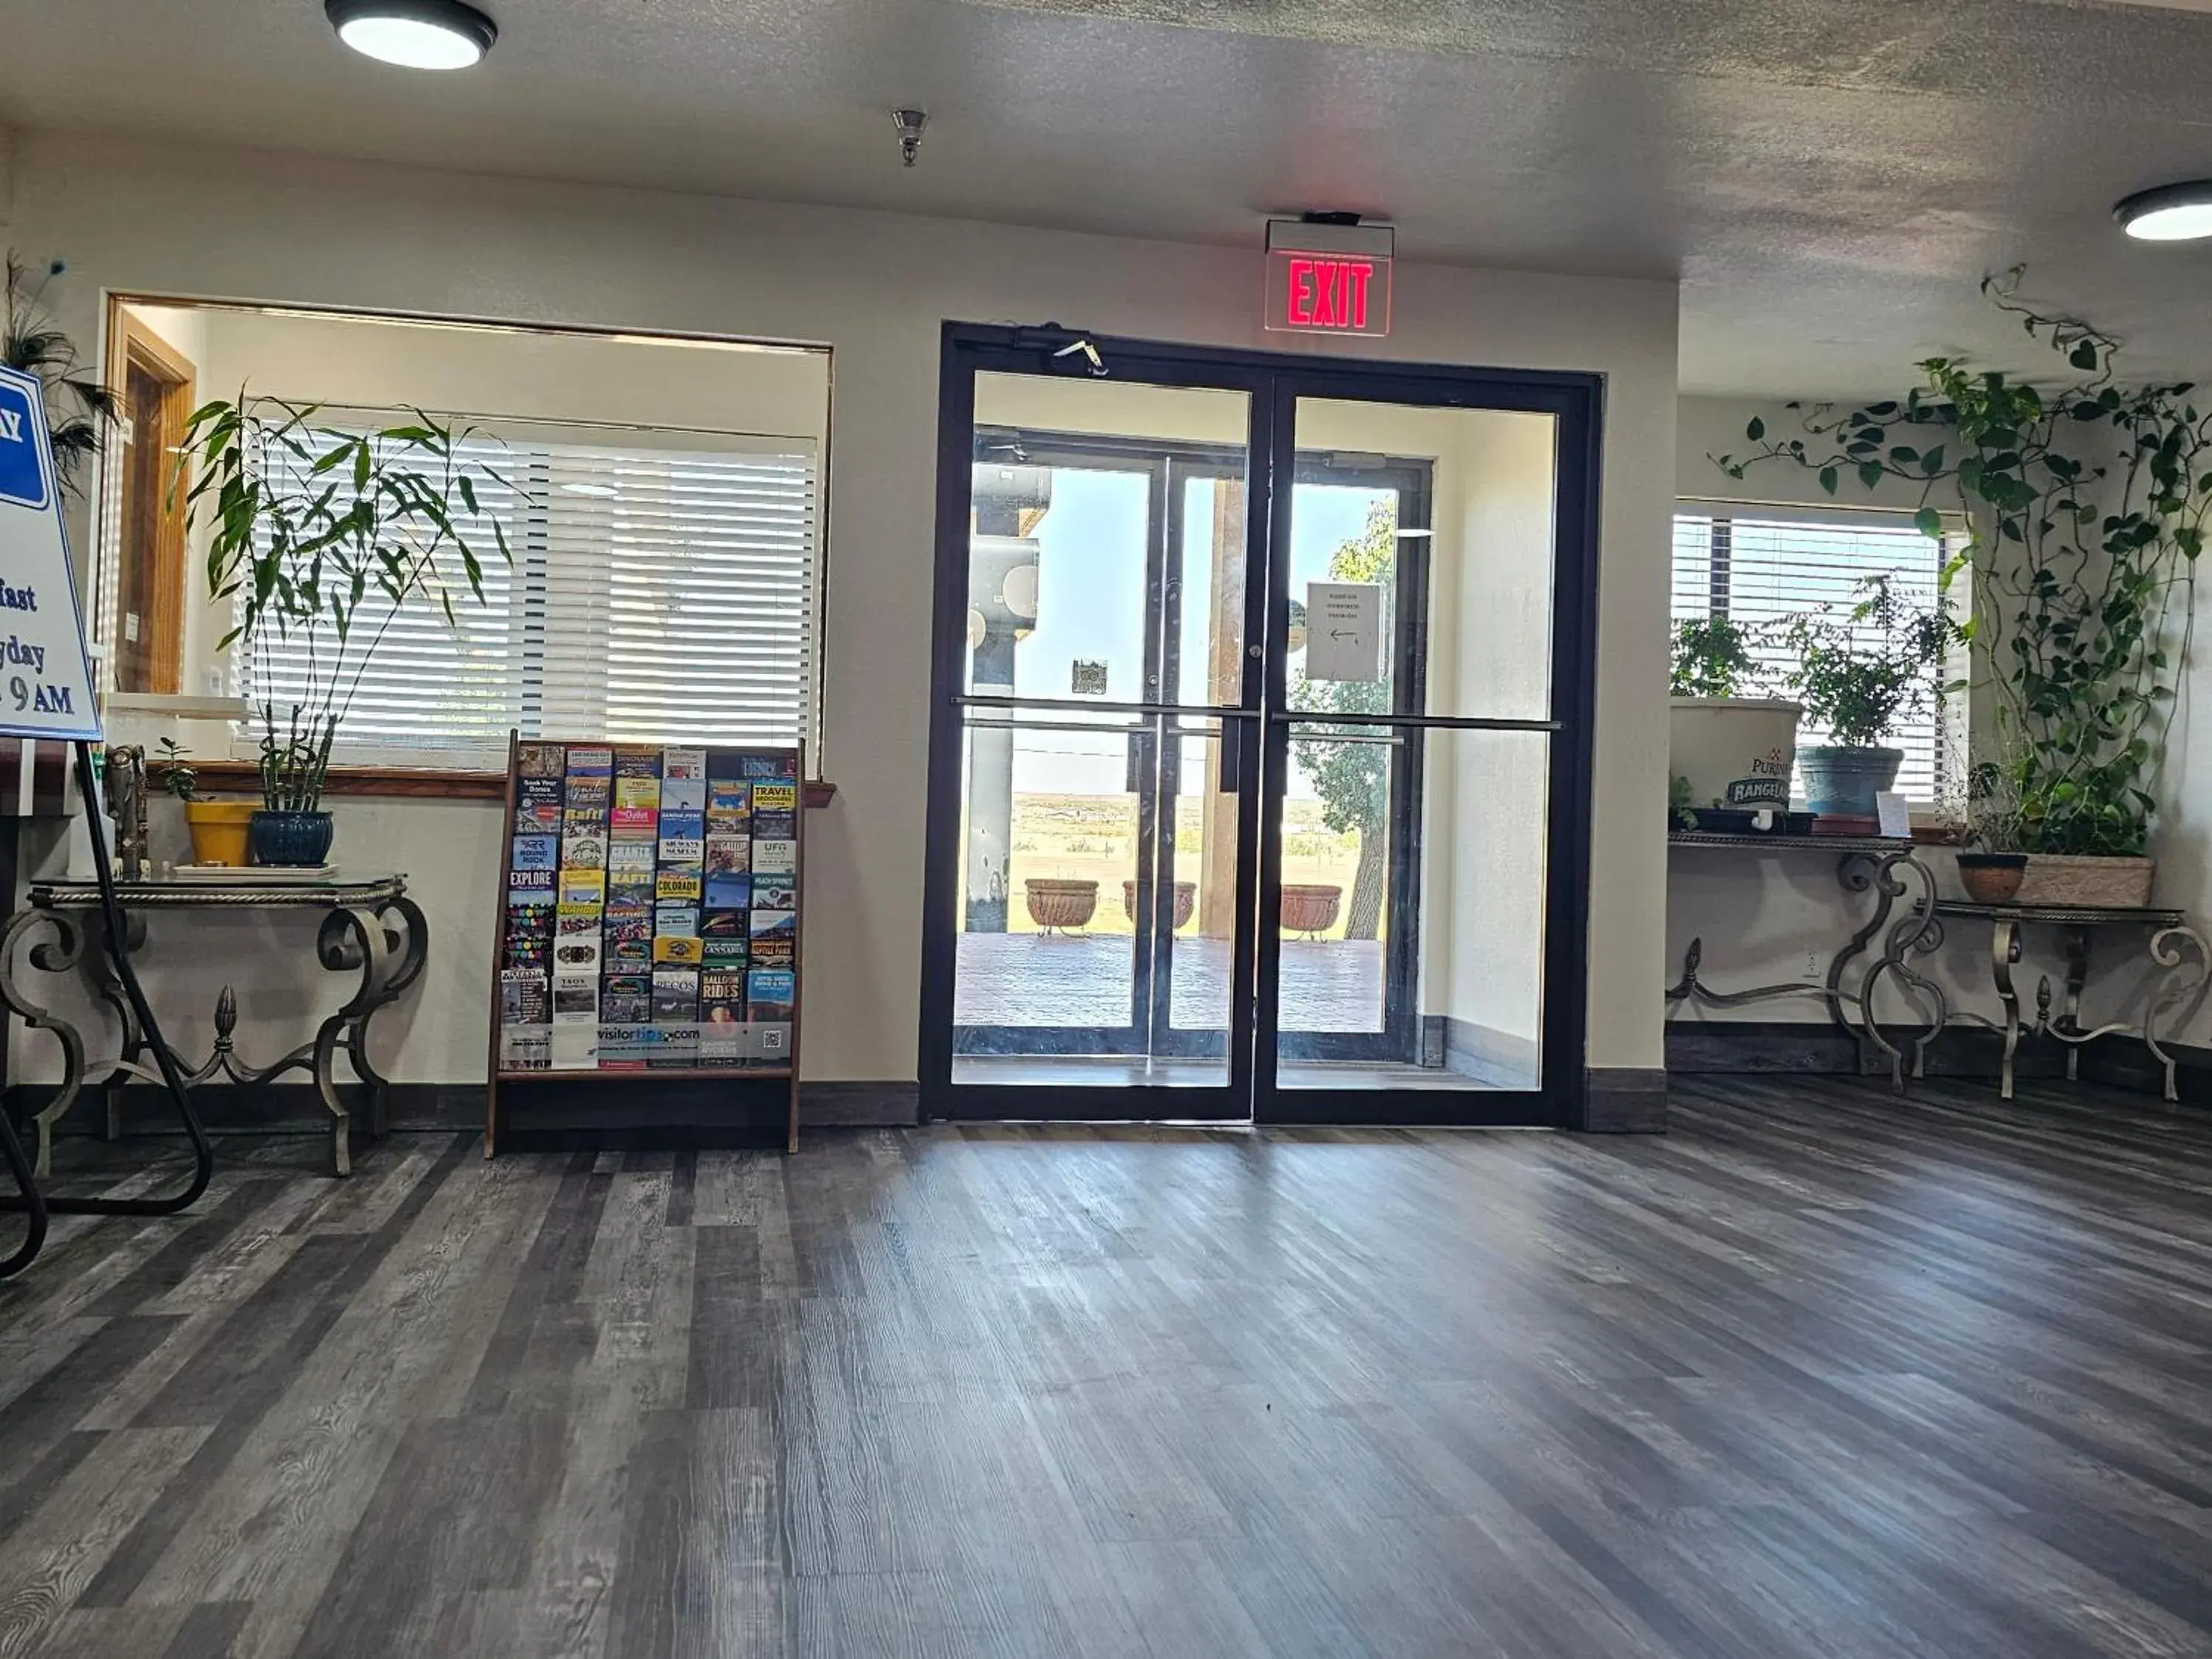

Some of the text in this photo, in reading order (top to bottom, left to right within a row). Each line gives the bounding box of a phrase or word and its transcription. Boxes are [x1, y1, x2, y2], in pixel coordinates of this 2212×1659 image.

[1289, 259, 1373, 328] EXIT
[10, 676, 75, 714] 9 AM
[754, 787, 793, 796] TRAVEL
[510, 871, 552, 886] EXPLORE
[658, 881, 698, 892] COLORADO
[702, 984, 739, 998] RIDES
